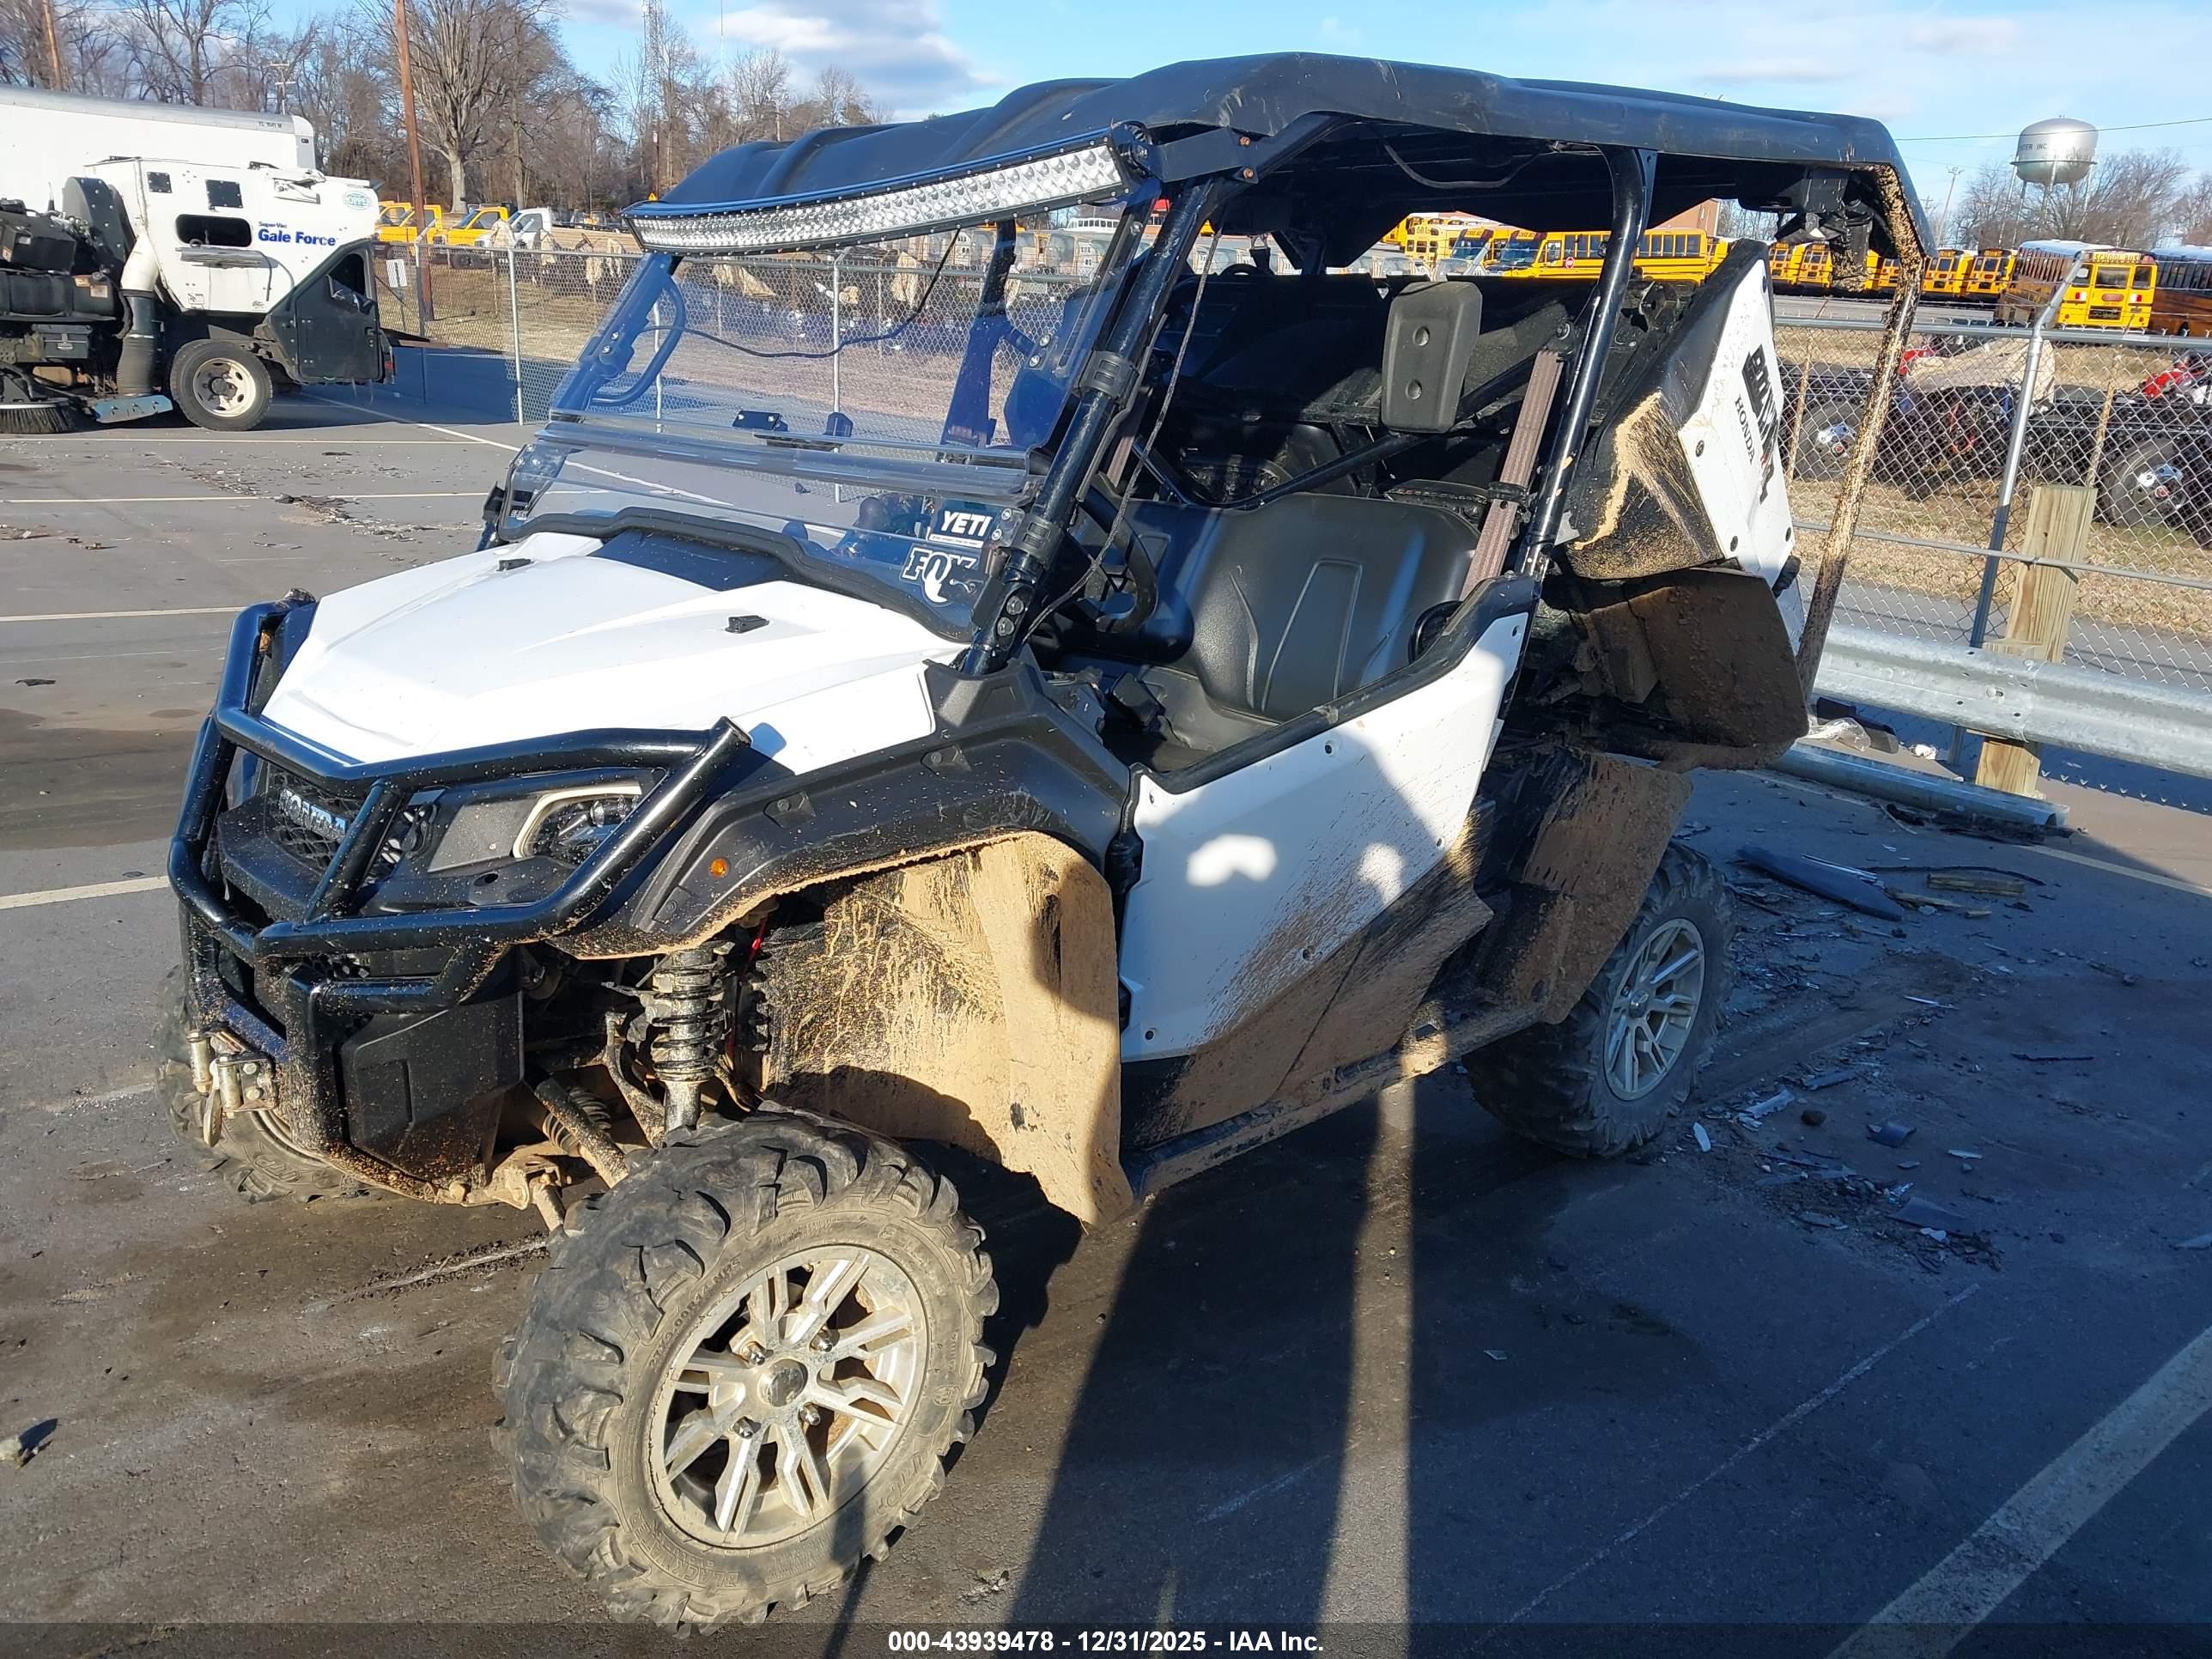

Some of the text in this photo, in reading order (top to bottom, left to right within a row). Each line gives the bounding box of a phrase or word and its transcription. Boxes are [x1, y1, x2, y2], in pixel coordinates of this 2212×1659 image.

[258, 228, 336, 246] Gale Force
[2095, 253, 2139, 263] SCHOOL BUS
[1735, 395, 1755, 465] HONDA
[941, 511, 993, 537] YETI
[902, 547, 977, 602] FOX
